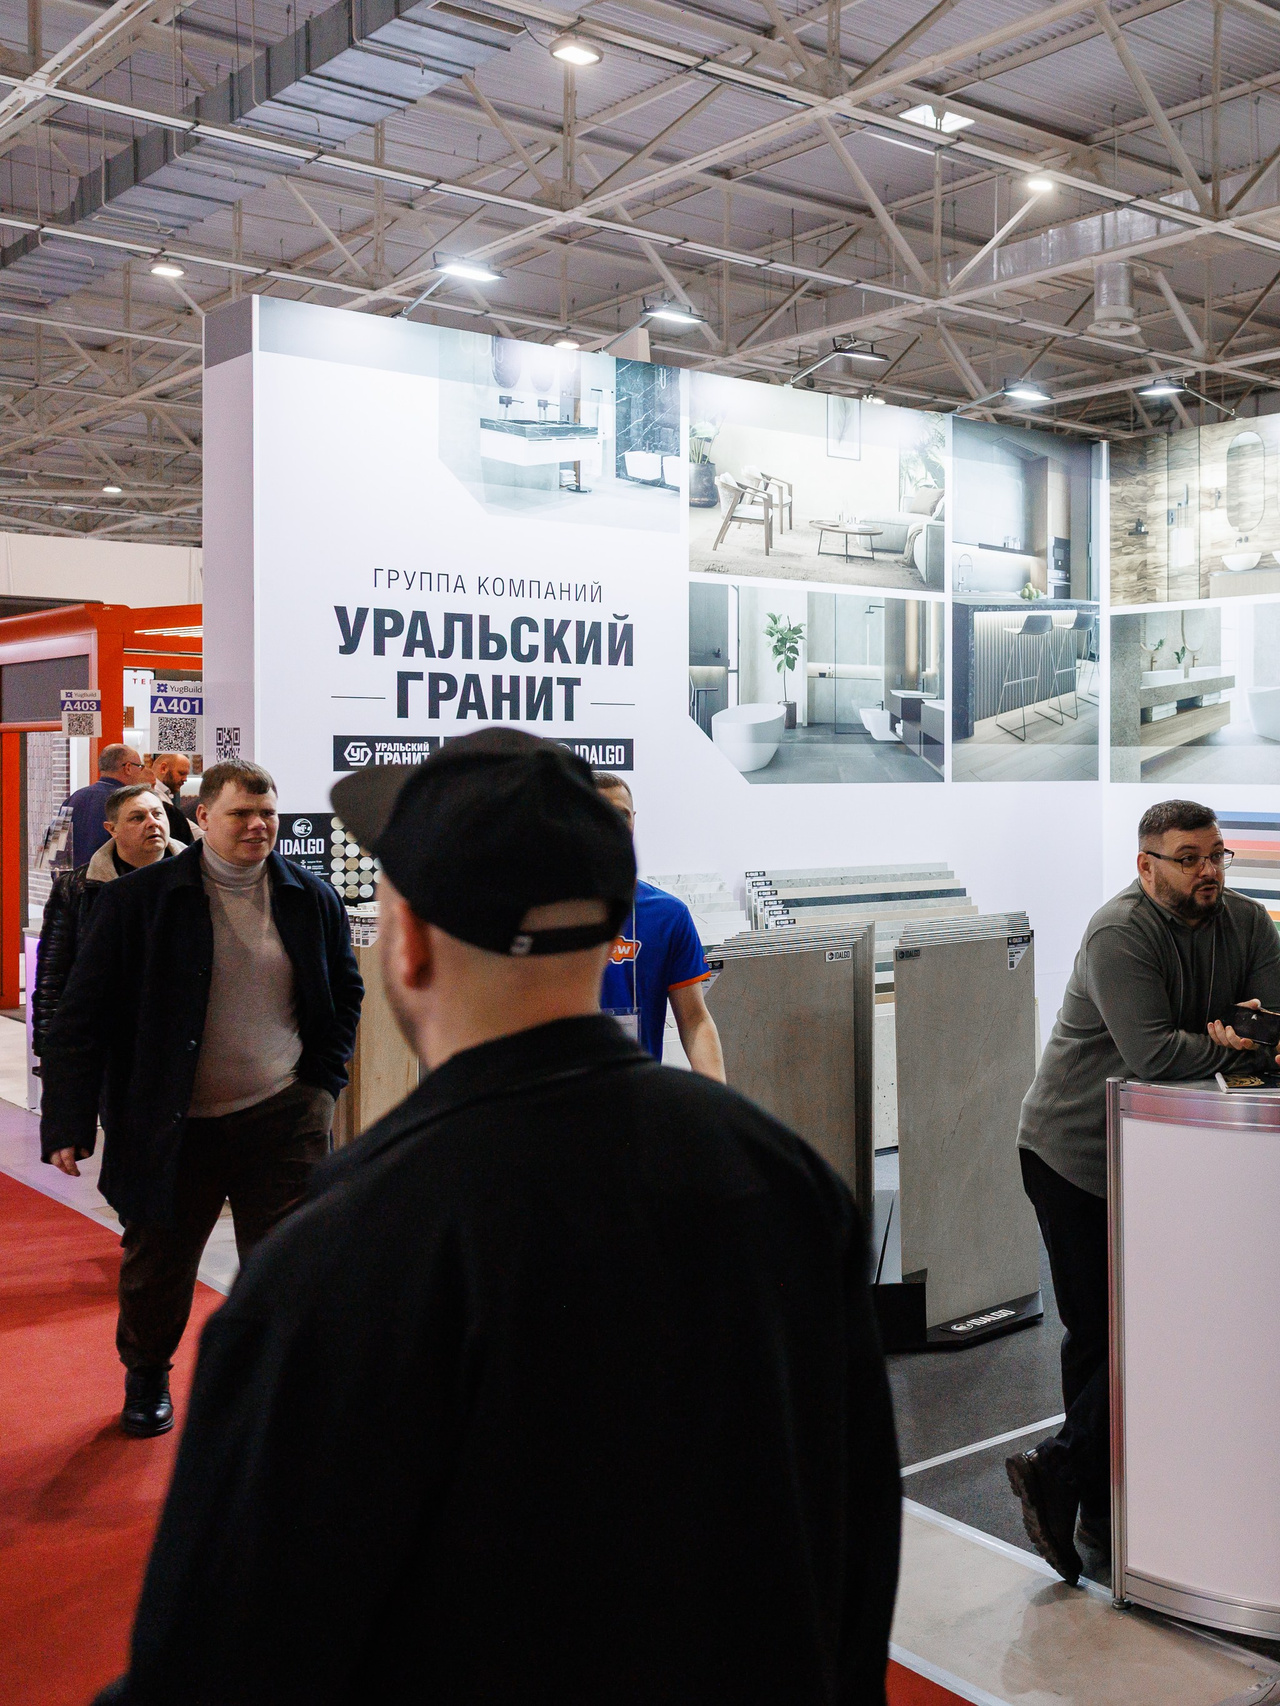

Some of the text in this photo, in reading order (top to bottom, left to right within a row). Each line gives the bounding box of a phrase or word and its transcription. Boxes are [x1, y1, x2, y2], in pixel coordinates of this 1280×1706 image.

[374, 568, 602, 603] ГРУППА КОМПАНИЙ
[333, 605, 634, 666] УРАЛЬСКИЙ
[170, 685, 202, 694] YugBuild
[396, 671, 582, 721] ГРАНИТ
[63, 701, 97, 711] A403
[153, 698, 200, 713] A401
[375, 741, 430, 751] УРАЛЬСКИЙ
[280, 838, 325, 855] IDALGO
[835, 950, 851, 959] IDALGO
